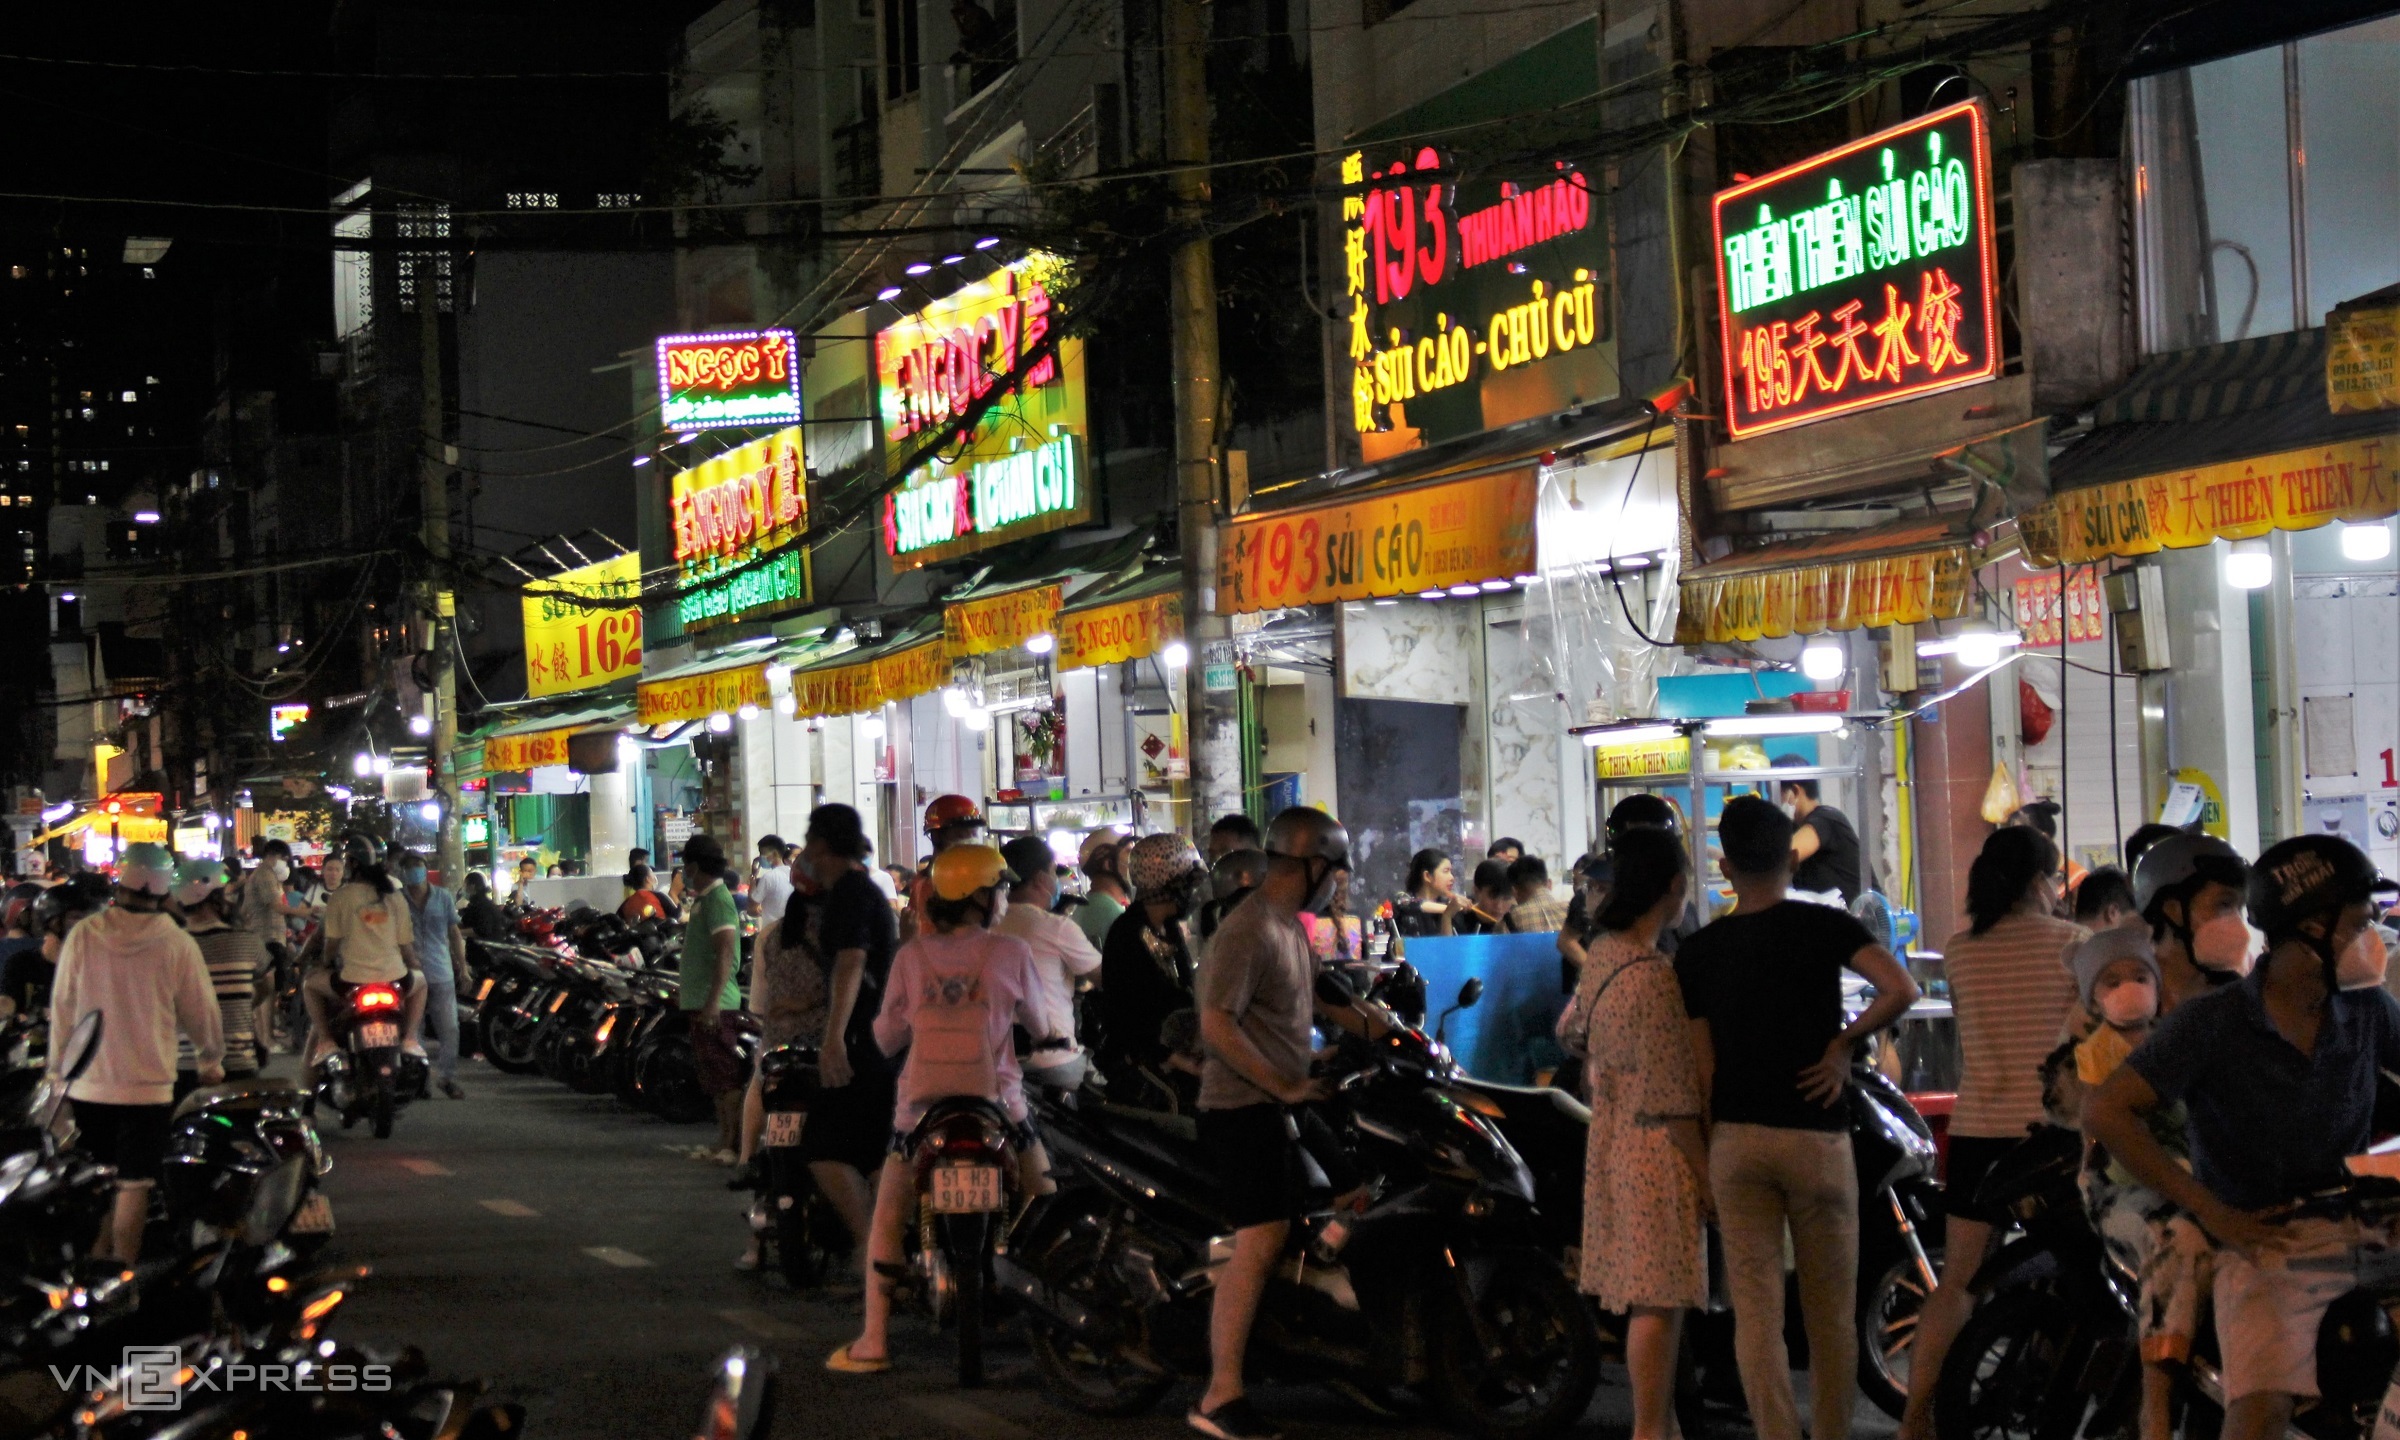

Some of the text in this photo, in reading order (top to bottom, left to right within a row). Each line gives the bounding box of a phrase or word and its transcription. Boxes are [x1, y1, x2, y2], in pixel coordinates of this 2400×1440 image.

[1364, 147, 1446, 305] 193
[1725, 131, 1969, 313] THIÊN THIÊN SỦI CẢO
[667, 346, 760, 389] NGỌC
[1375, 327, 1415, 405] SỦI
[1417, 312, 1469, 392] CẢO
[1490, 279, 1549, 371] CHỦ
[692, 473, 752, 556] NGỌC
[2084, 490, 2115, 548] SỦI
[2118, 484, 2150, 543] CẢO
[2206, 465, 2274, 528] THIÊN
[2281, 452, 2354, 516] THIÊN
[1247, 517, 1320, 602] 193
[1325, 512, 1364, 587] SỦI
[1373, 503, 1423, 586] CẢO
[576, 610, 642, 678] 162
[1087, 614, 1134, 652] NGỌC
[650, 689, 692, 715] NGỌC
[517, 737, 556, 764] 162
